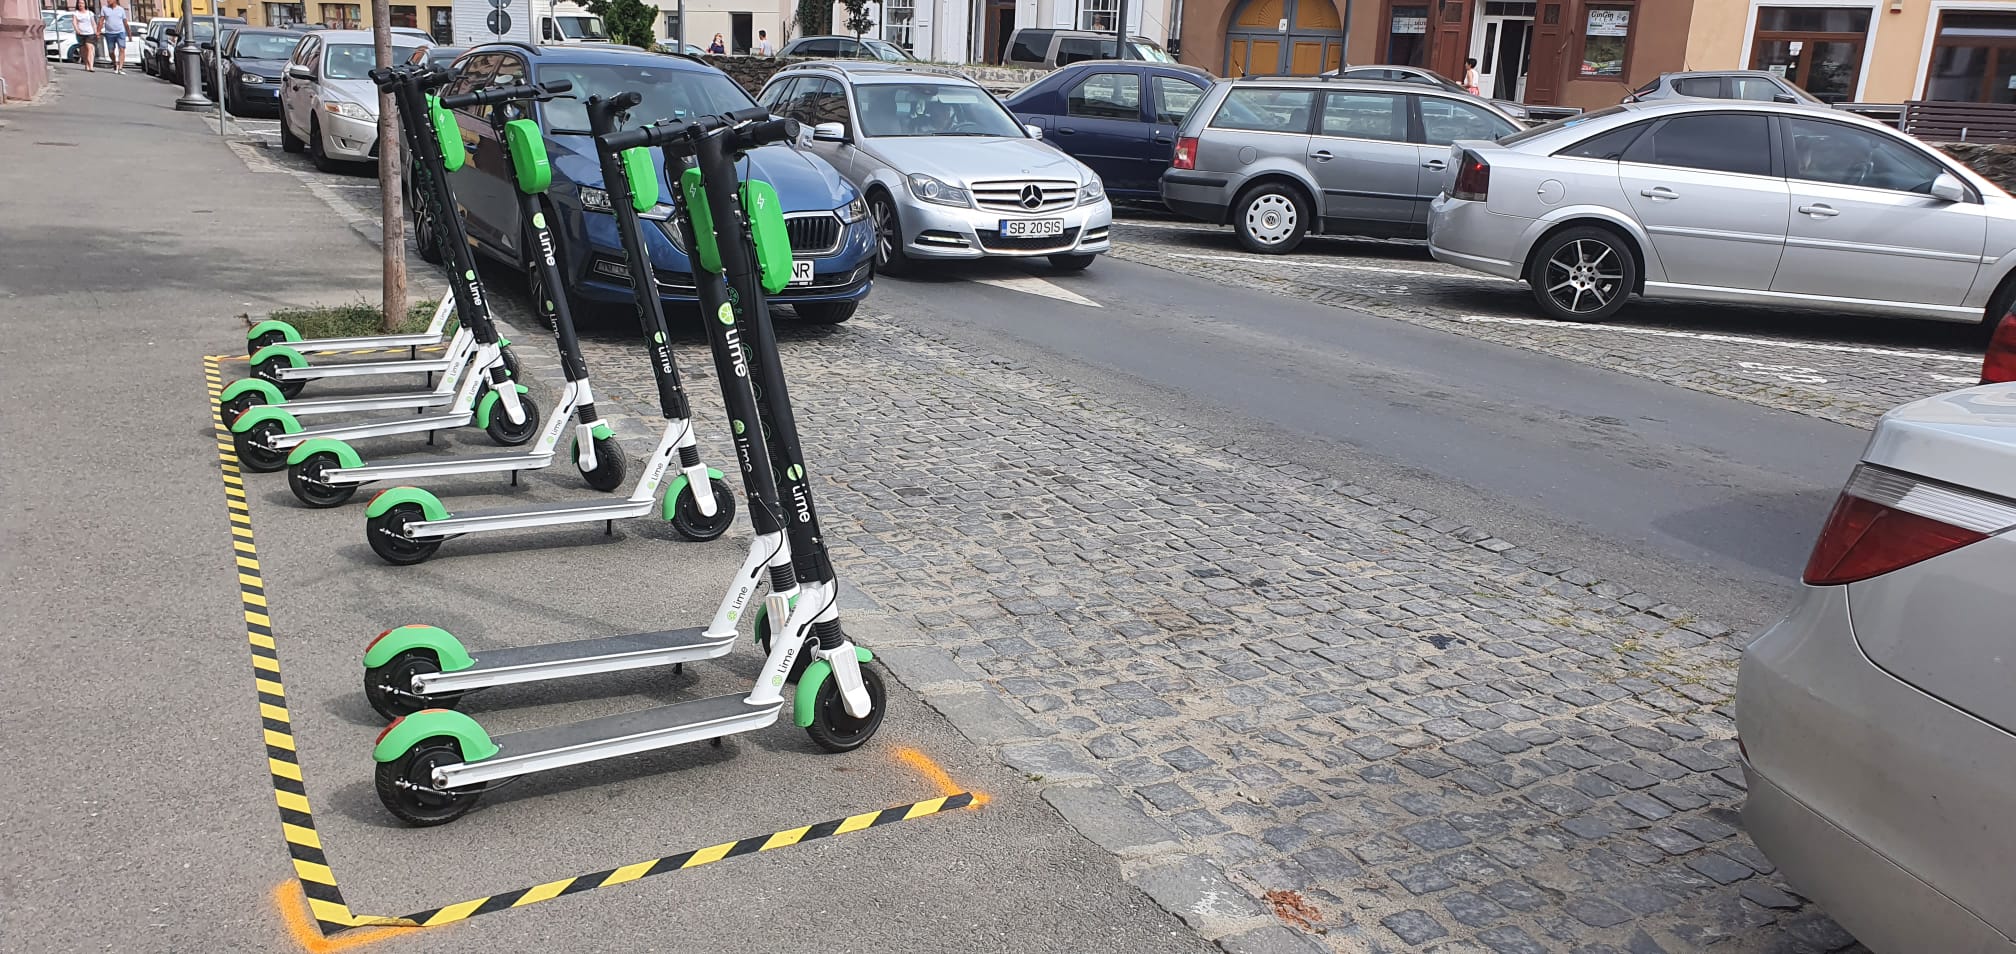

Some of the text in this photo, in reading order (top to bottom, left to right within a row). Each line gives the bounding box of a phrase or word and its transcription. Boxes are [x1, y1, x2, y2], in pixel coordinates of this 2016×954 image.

[1009, 222, 1026, 234] SB
[538, 231, 556, 266] Lime
[468, 281, 482, 307] Lime
[657, 345, 673, 374] Lime
[725, 328, 748, 378] Lime
[651, 462, 664, 481] Lime
[792, 482, 811, 523] Lime
[731, 586, 749, 610] Lime
[777, 648, 795, 674] Lime
